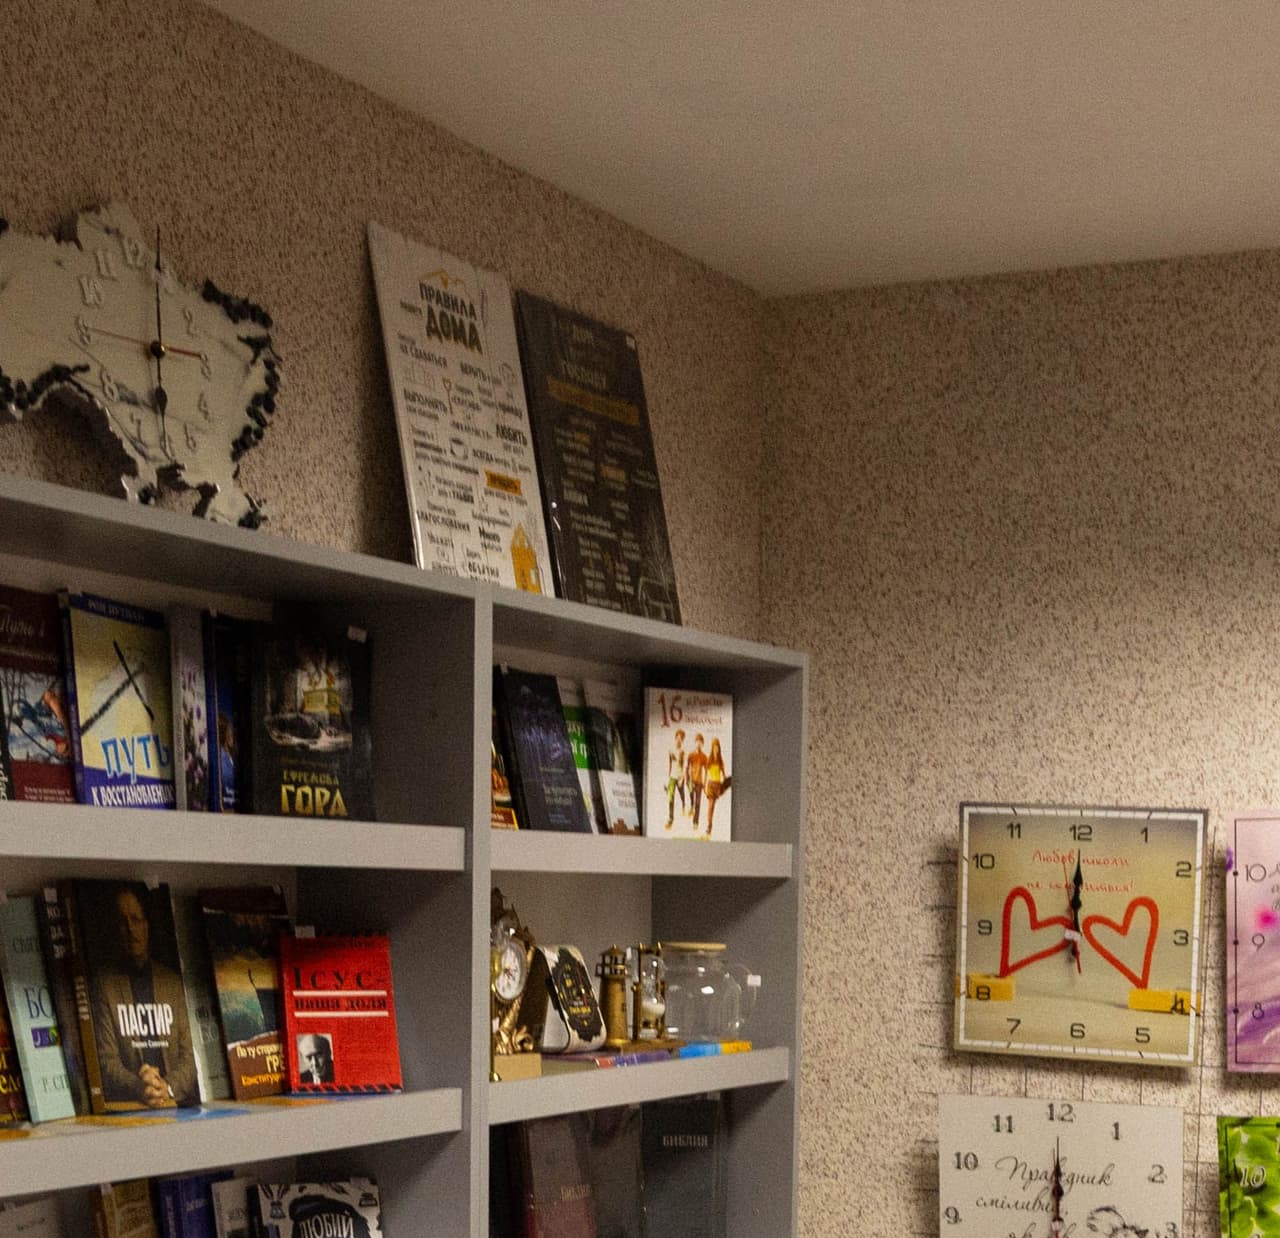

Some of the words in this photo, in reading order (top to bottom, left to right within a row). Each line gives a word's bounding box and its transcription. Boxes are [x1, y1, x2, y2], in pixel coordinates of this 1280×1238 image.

[419, 283, 478, 320] ПРАВИЛА
[426, 304, 483, 354] ДОМА
[658, 692, 682, 728] 16
[101, 734, 170, 784] ПУТЬ
[280, 783, 348, 817] ГОРА
[1006, 823, 1022, 840] 11
[1070, 824, 1093, 842] 12
[1140, 827, 1149, 842] 1
[117, 1003, 173, 1037] ПАСТИР
